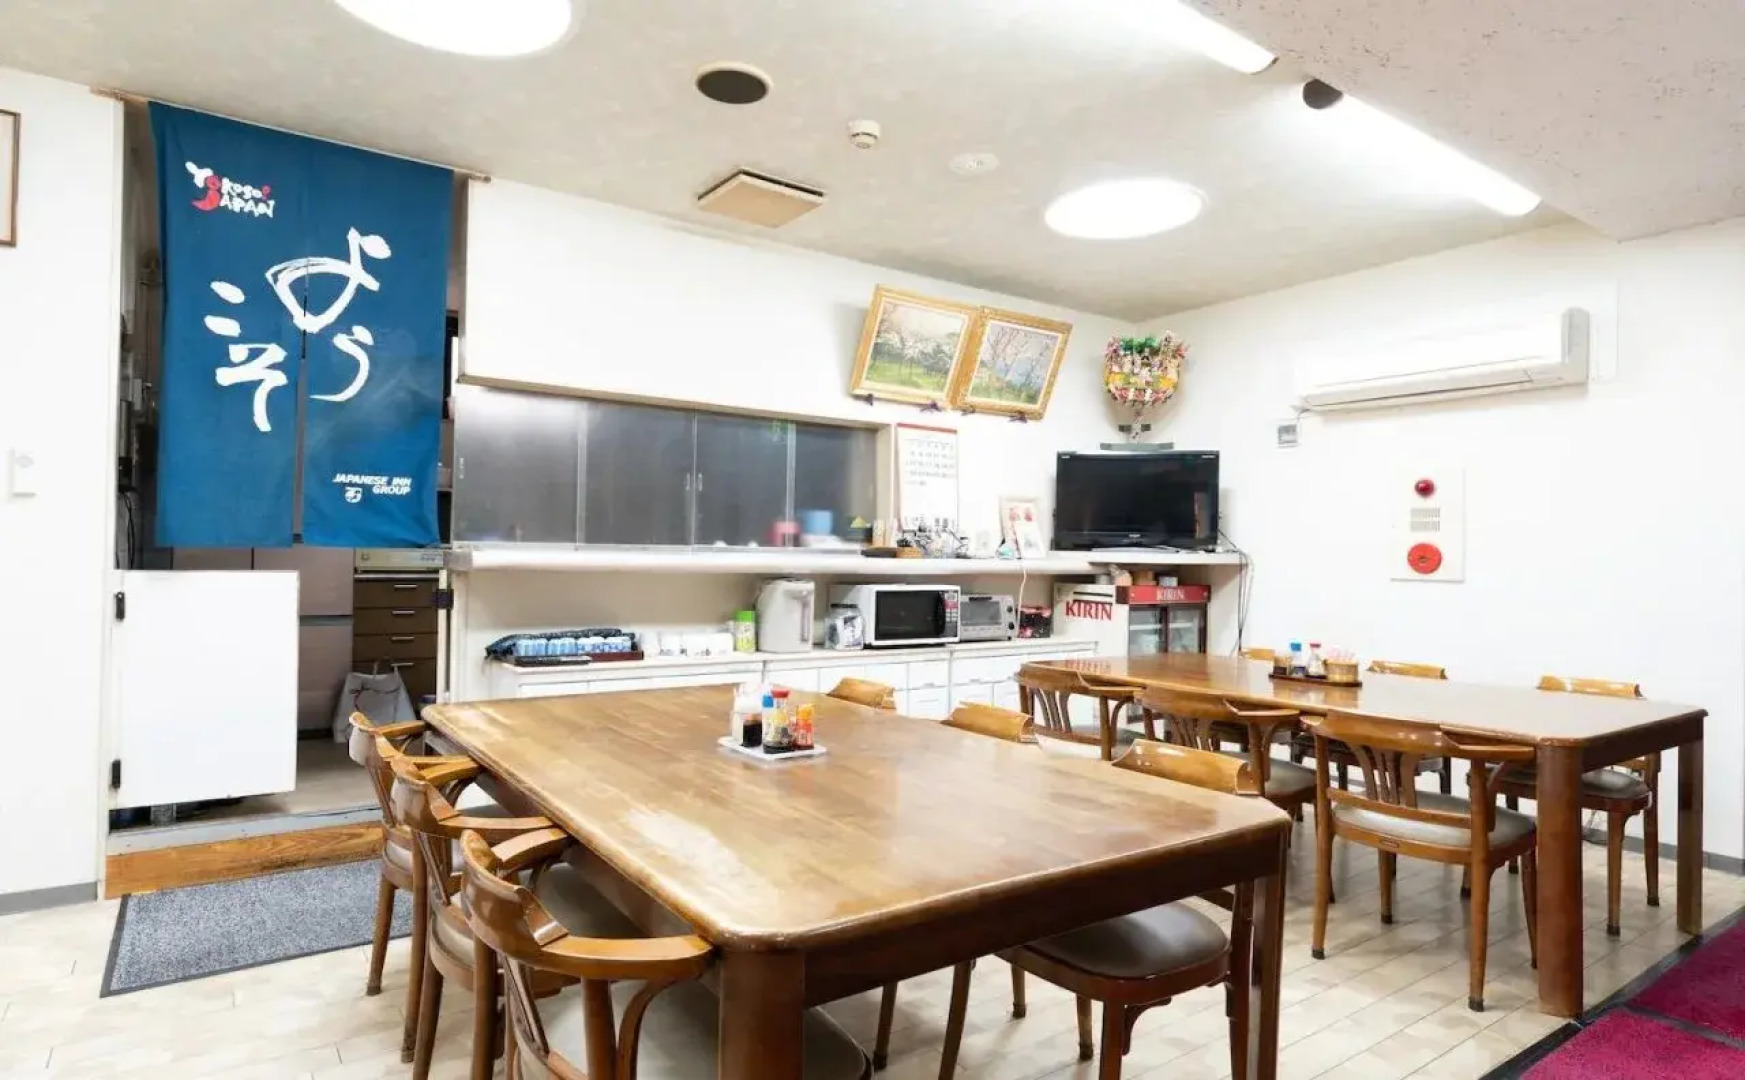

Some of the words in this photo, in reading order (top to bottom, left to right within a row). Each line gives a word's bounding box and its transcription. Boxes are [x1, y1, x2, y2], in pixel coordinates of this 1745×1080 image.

[332, 472, 388, 485] JAPANESE
[392, 476, 412, 487] INN
[372, 484, 411, 495] GROUP
[1157, 588, 1186, 600] KIRIN
[1065, 599, 1112, 621] KIRIN
